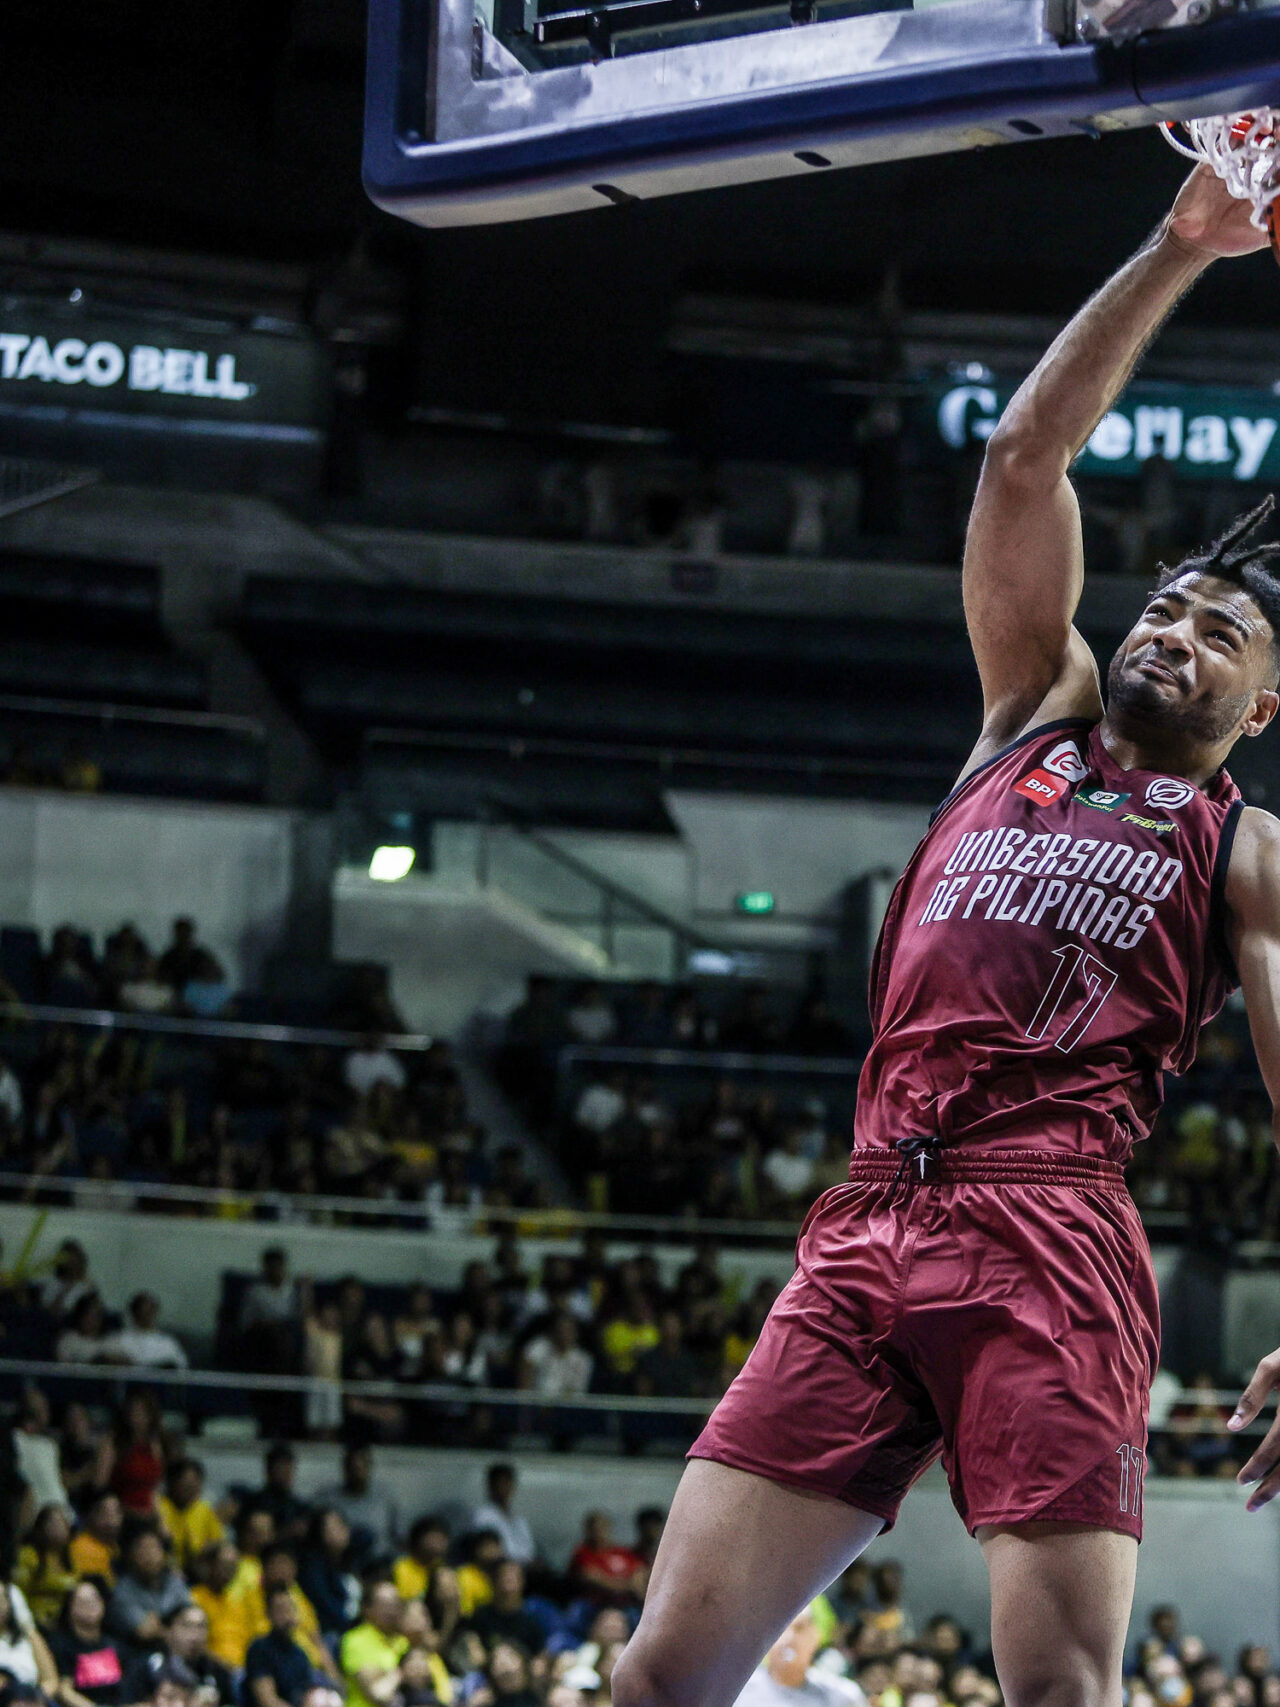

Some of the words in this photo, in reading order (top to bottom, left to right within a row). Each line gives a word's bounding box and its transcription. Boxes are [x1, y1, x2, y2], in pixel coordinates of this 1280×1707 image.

[0, 332, 125, 388] TACO
[128, 344, 255, 401] BELL
[1024, 778, 1057, 799] BPI
[943, 826, 1184, 902] UNIBERSIDAD
[919, 875, 970, 927] NG
[961, 873, 1156, 950] PILIPINAS
[1024, 943, 1119, 1054] 17
[1115, 1443, 1143, 1517] 17
